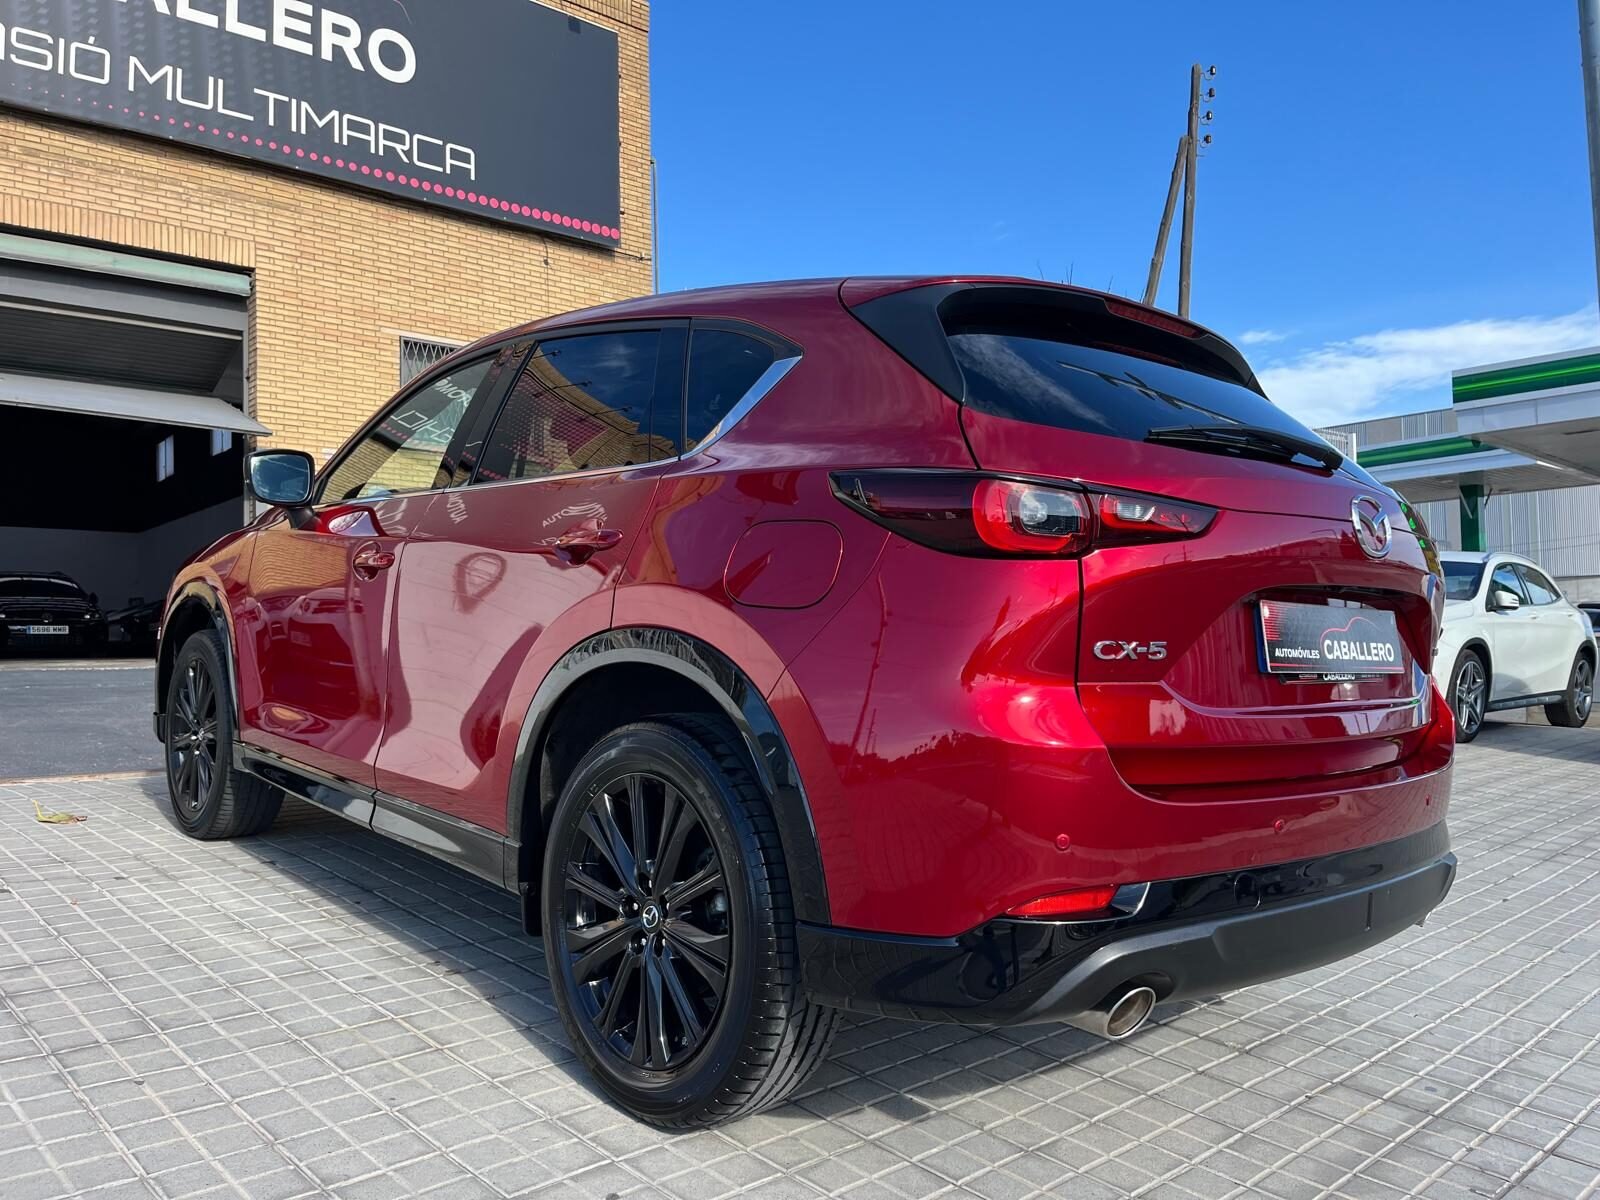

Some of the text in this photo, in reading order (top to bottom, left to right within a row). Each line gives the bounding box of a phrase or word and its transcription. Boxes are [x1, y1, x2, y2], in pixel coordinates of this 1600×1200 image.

[0, 22, 476, 181] SIÓ MULTIMARCA
[1093, 640, 1168, 660] CX-5
[1274, 639, 1395, 662] AUTOMÓVILES CABALLERO
